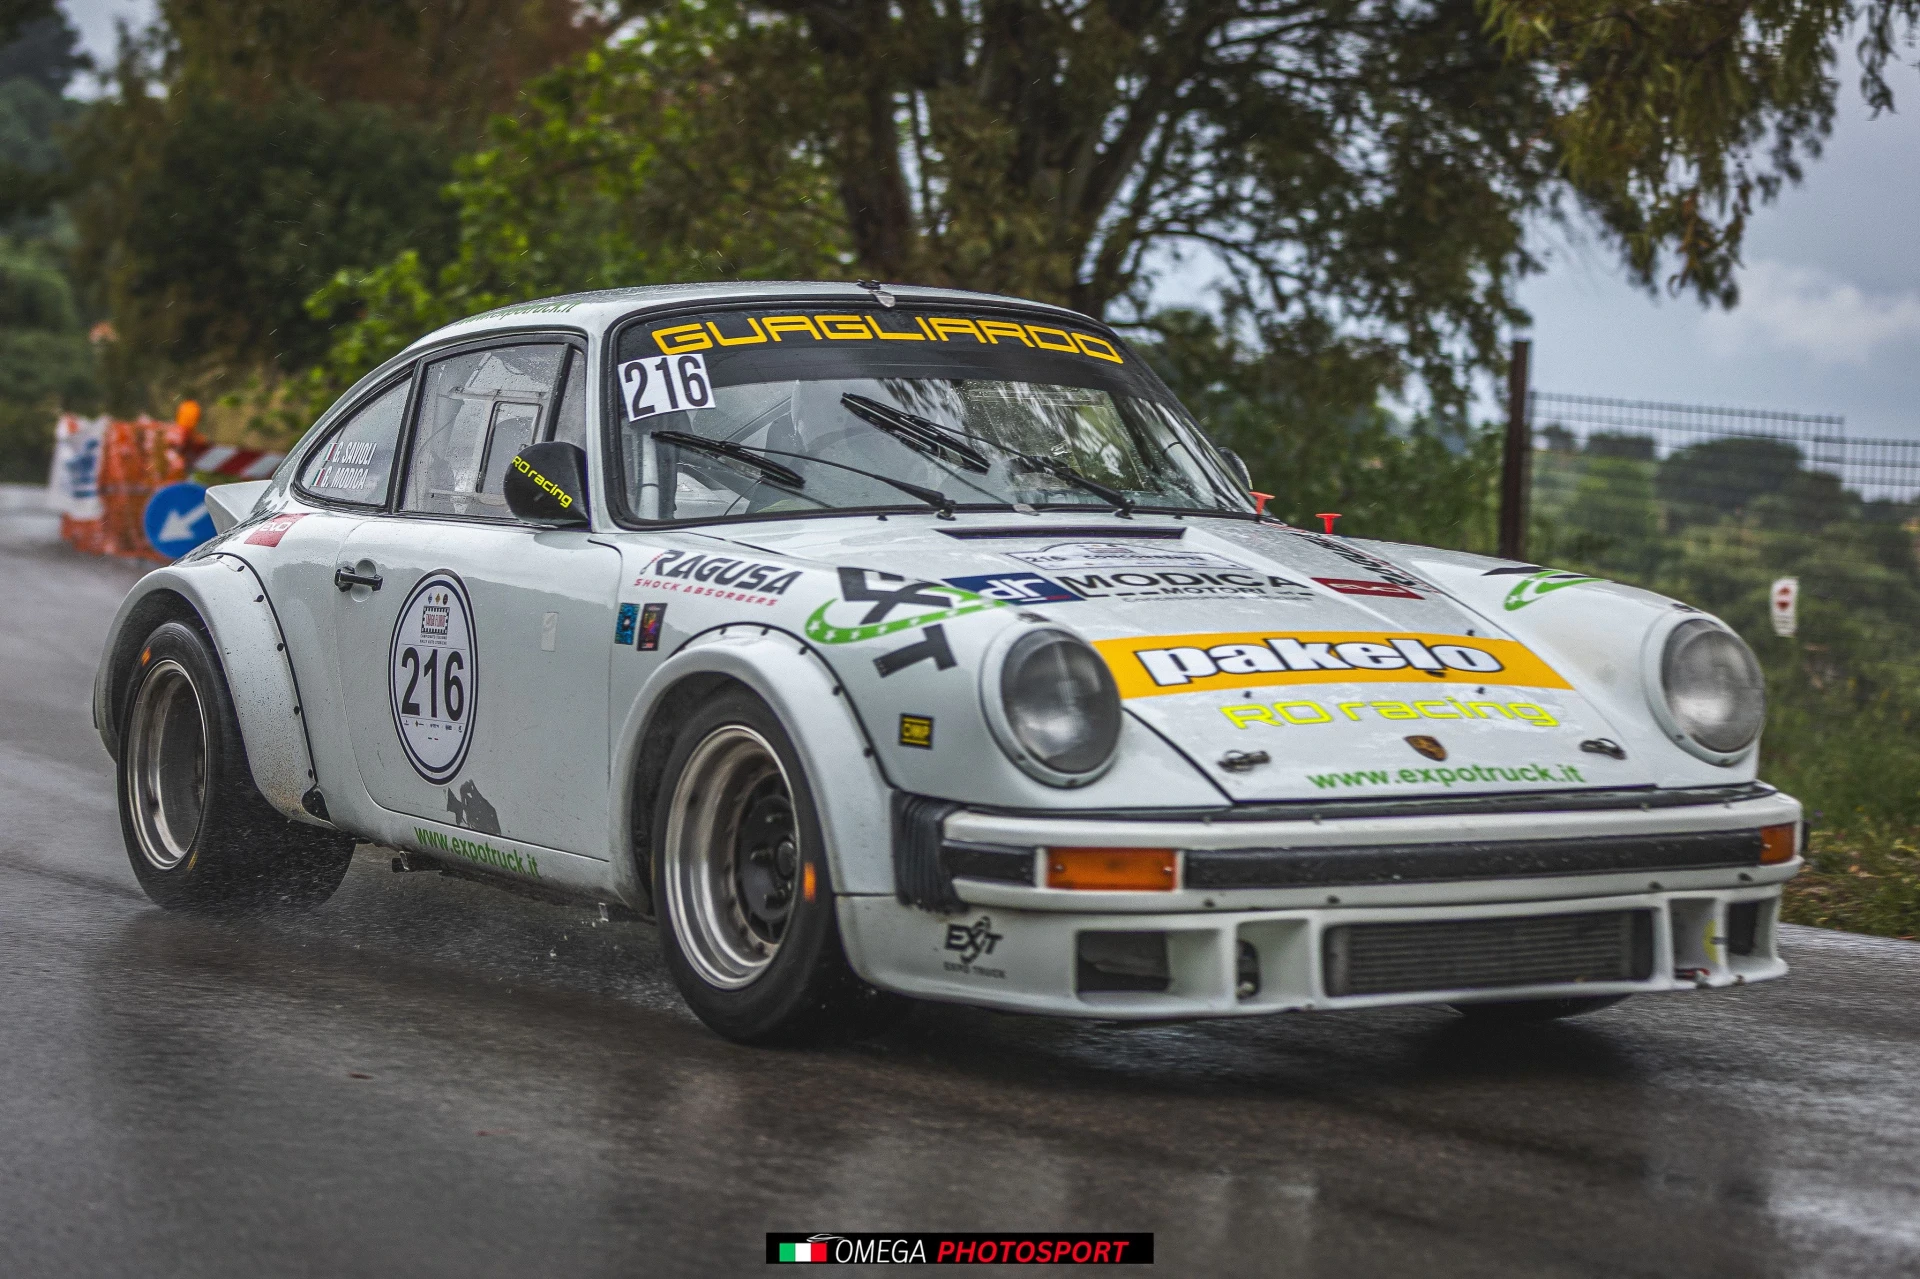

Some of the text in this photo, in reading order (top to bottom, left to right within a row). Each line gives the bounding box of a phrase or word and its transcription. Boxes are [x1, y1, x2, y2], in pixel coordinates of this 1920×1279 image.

[651, 315, 1124, 364] GUAGLIARDO
[624, 355, 709, 418] 216
[342, 442, 377, 466] SAVIOLI
[330, 467, 369, 489] MODICA
[527, 470, 573, 508] racing
[640, 549, 804, 595] RAGUSA
[977, 578, 1046, 598] dr
[1055, 573, 1312, 597] MODICA
[634, 578, 779, 606] SHOCK ABSORBERS
[1159, 586, 1267, 595] MOTORI
[1133, 638, 1504, 687] pakelo
[401, 647, 464, 721] 216
[1337, 695, 1559, 727] racing
[1305, 764, 1586, 789] www.expotruck.it
[413, 826, 540, 879] www.expotruck.it
